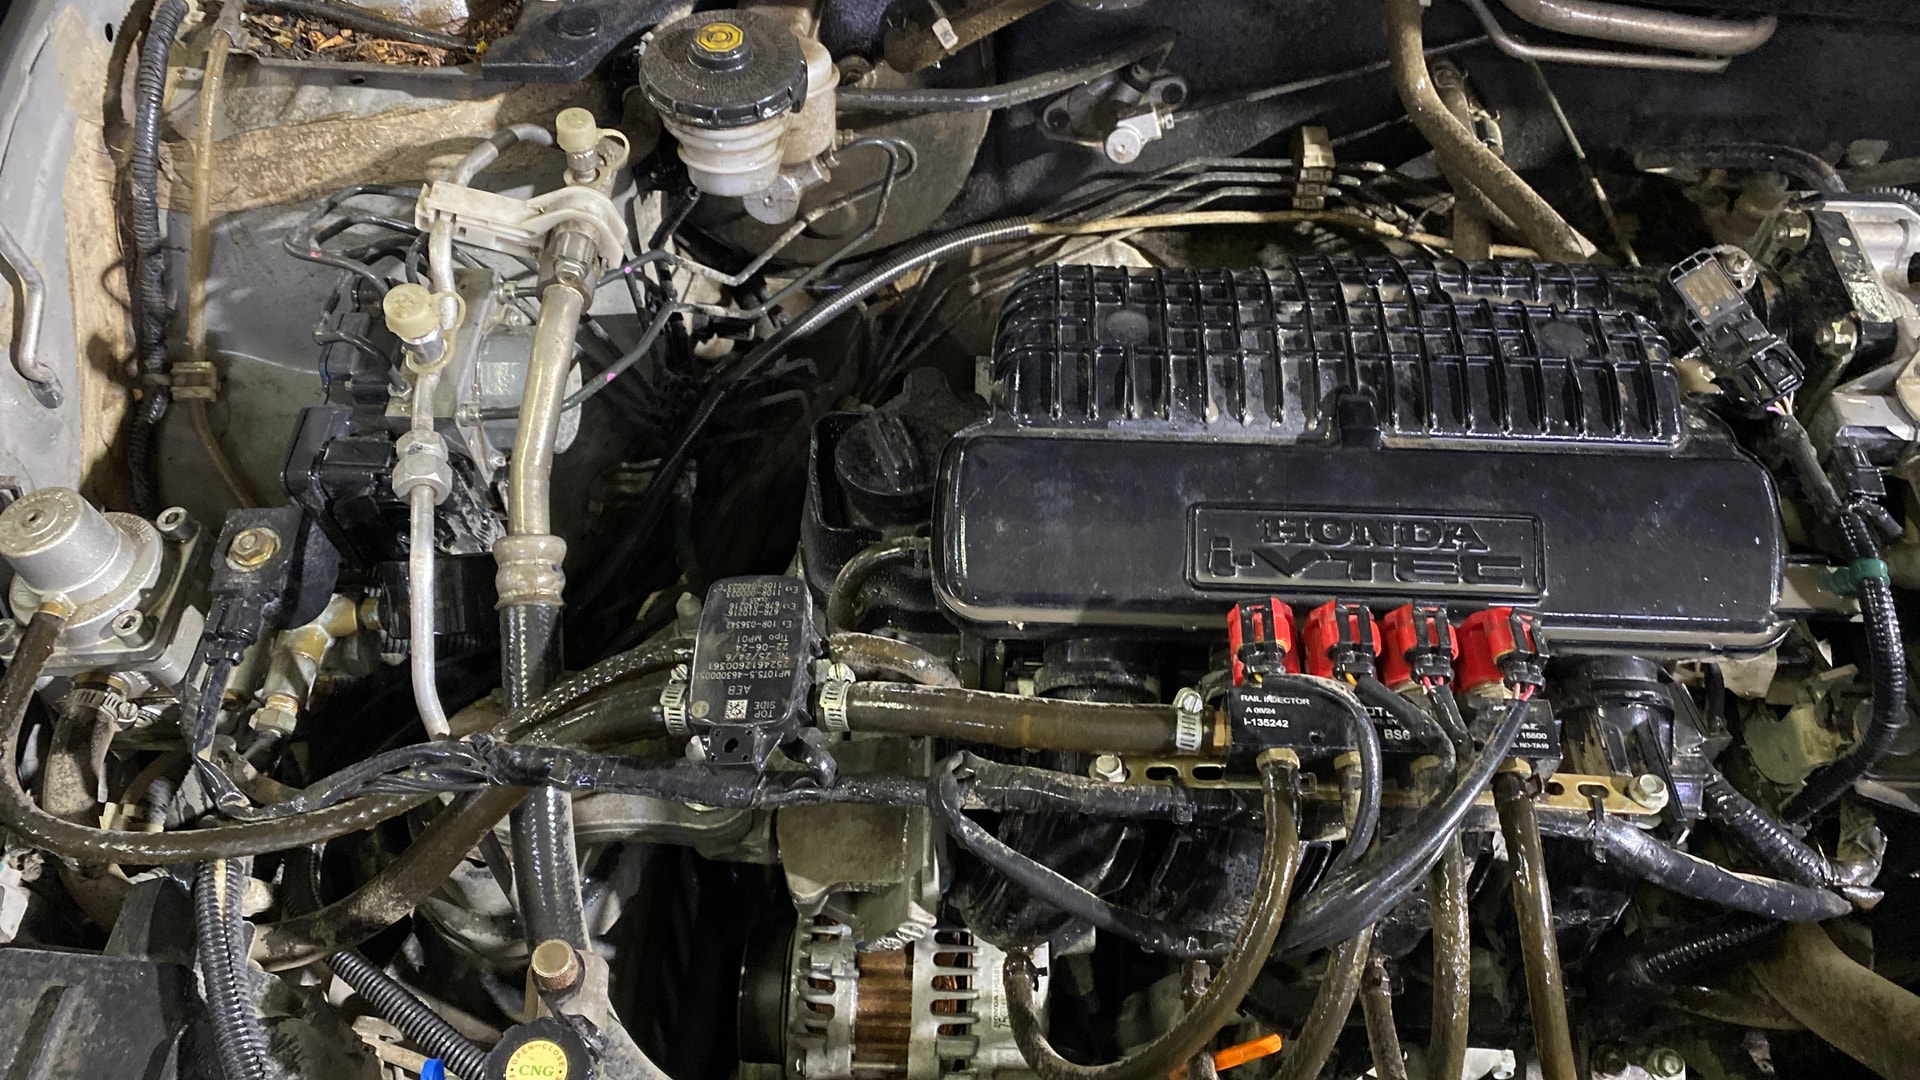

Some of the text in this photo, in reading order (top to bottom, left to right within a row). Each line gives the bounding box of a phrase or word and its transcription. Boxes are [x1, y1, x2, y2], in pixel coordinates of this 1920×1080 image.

[1260, 516, 1491, 552] HONDA
[737, 632, 789, 643] Tipo MP01
[735, 642, 789, 651] 22-06-24
[727, 684, 752, 696] AEB
[1240, 694, 1263, 703] RAIL
[753, 700, 776, 710] SIDE
[1245, 706, 1253, 714] A
[754, 709, 774, 719] TOP
[1242, 717, 1290, 728] I-135242
[1383, 728, 1411, 741] BS6
[511, 1043, 566, 1067] OPEN CLOSE
[518, 1064, 555, 1077] CNG
